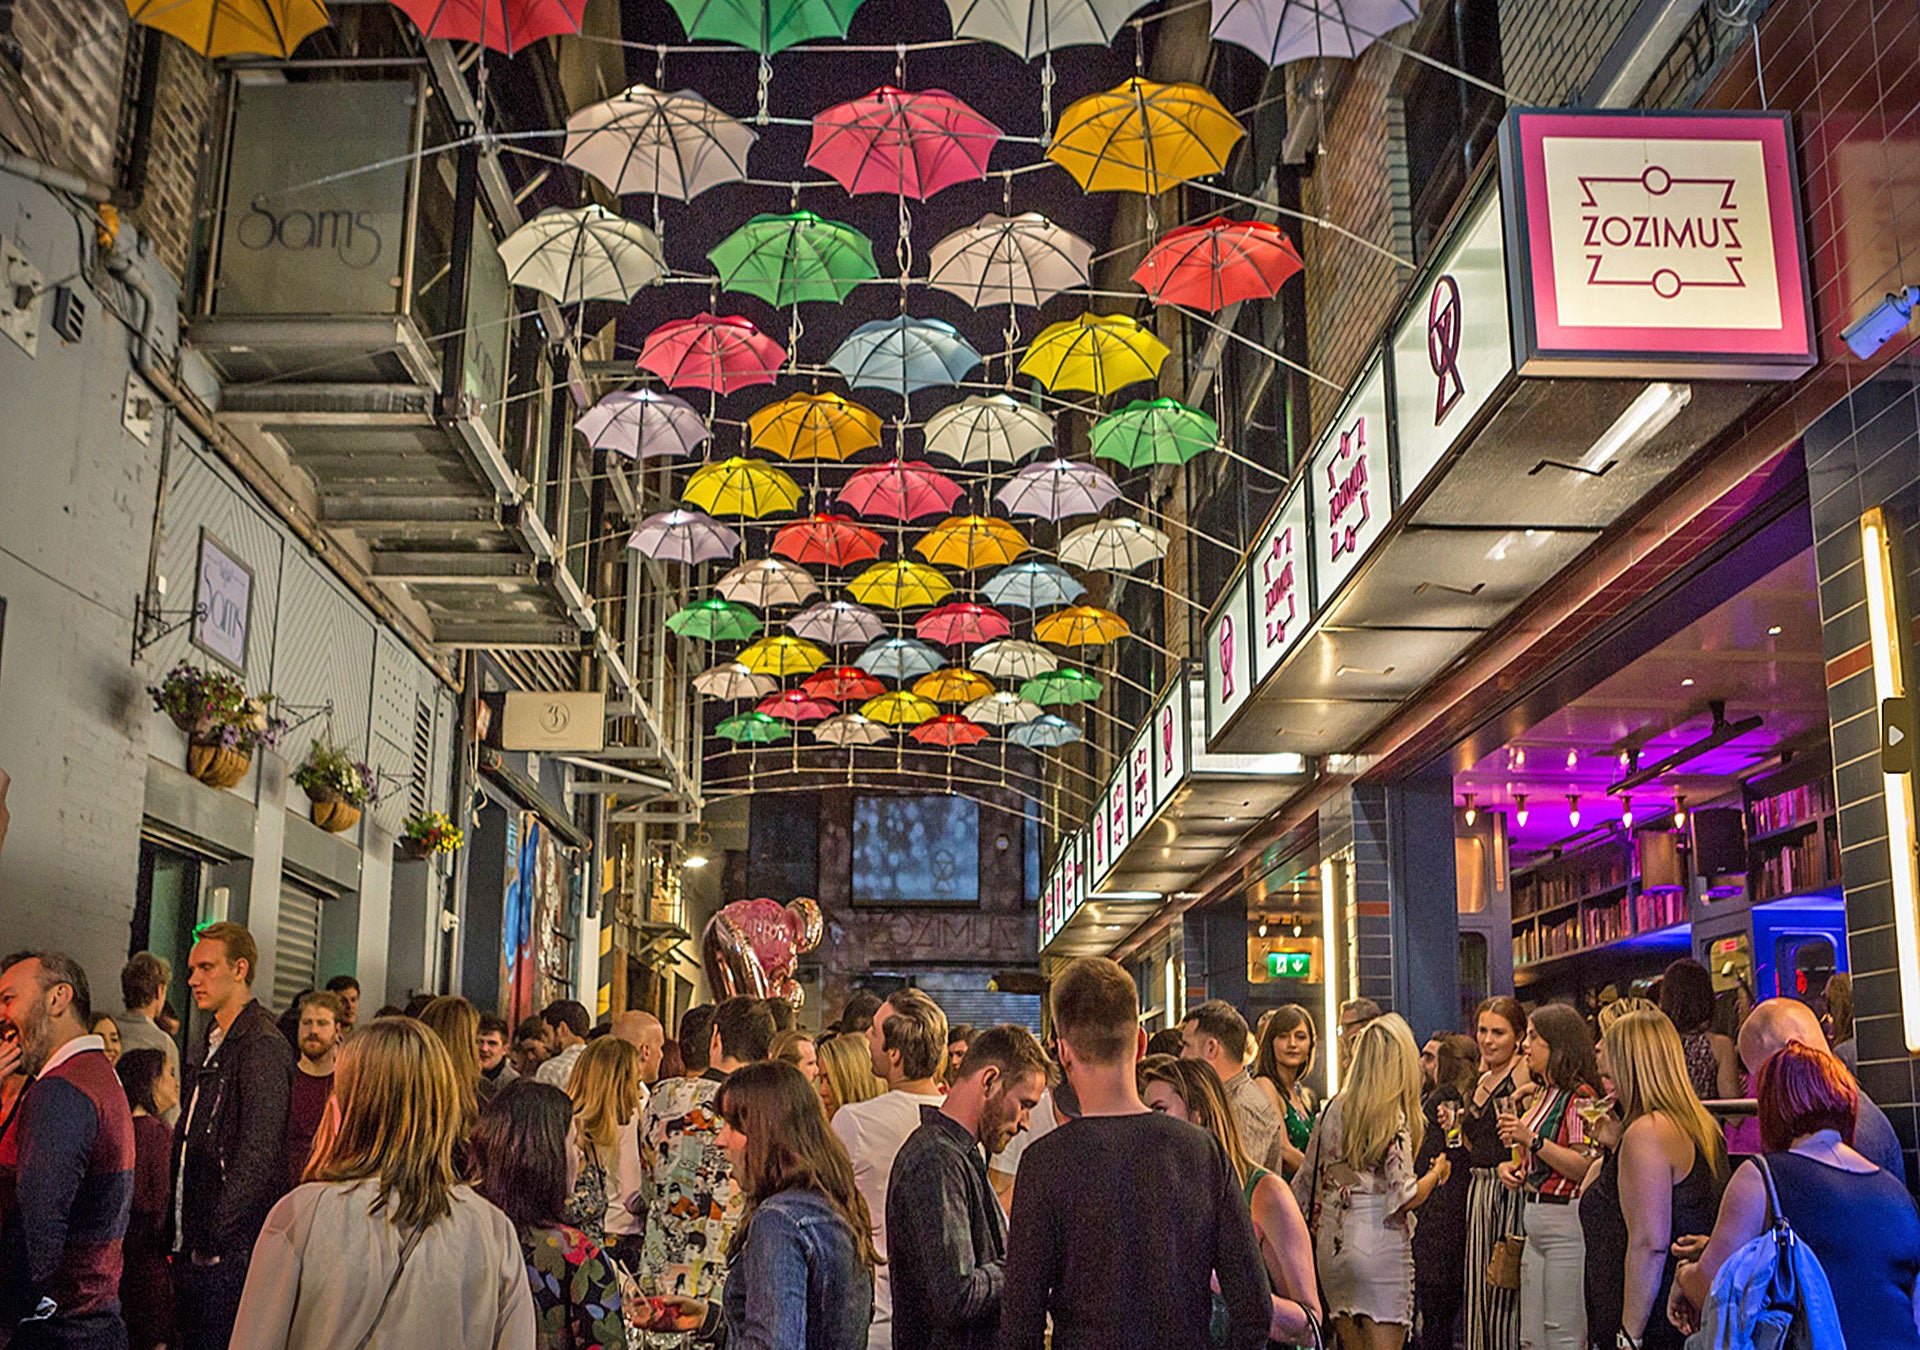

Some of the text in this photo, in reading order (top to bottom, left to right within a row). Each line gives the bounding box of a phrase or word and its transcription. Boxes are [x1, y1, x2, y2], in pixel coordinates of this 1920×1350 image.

[238, 199, 382, 269] Sams
[1582, 215, 1742, 249] ZOZIMUS
[204, 563, 244, 662] Sams
